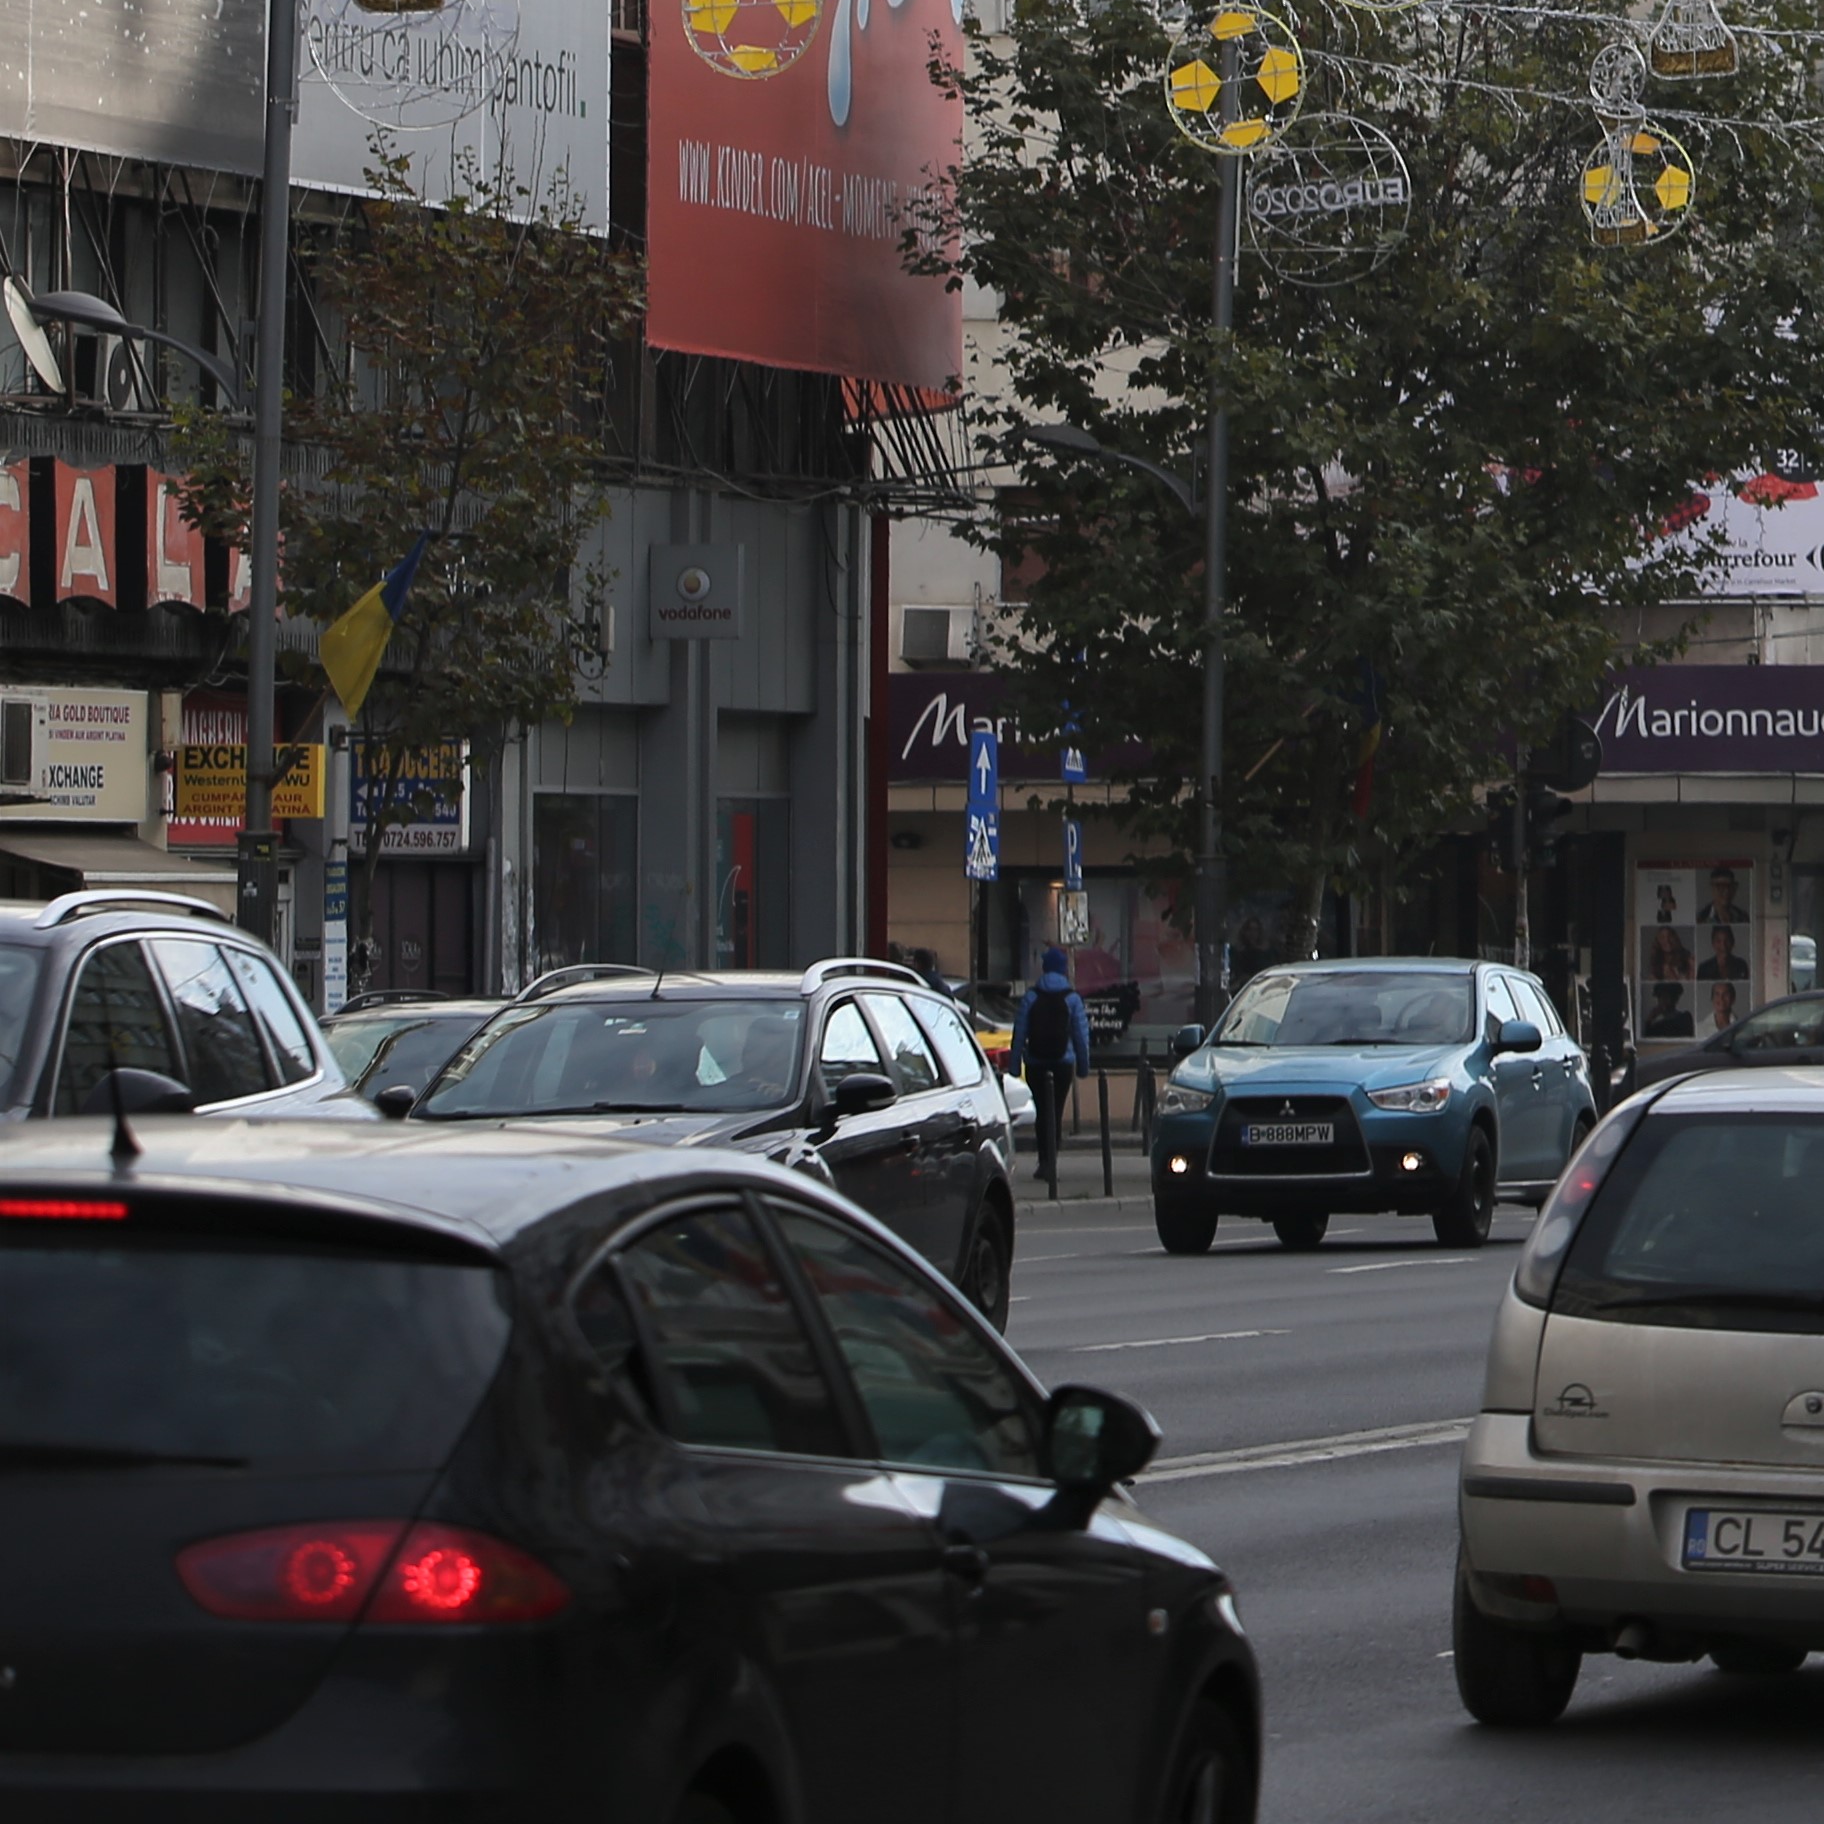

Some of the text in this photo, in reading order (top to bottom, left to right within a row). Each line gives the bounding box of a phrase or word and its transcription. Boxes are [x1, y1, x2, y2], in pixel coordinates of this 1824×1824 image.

[1776, 448, 1799, 468] 32
[1707, 550, 1798, 569] arrefour
[658, 603, 732, 622] vodafone
[63, 704, 87, 722] GOLD
[88, 705, 130, 724] BOUTIQUE
[184, 747, 310, 770] EXCHGE
[49, 764, 105, 789] XCHANGE
[382, 831, 457, 848] 0724.596.757
[1713, 1517, 1765, 1557] CL
